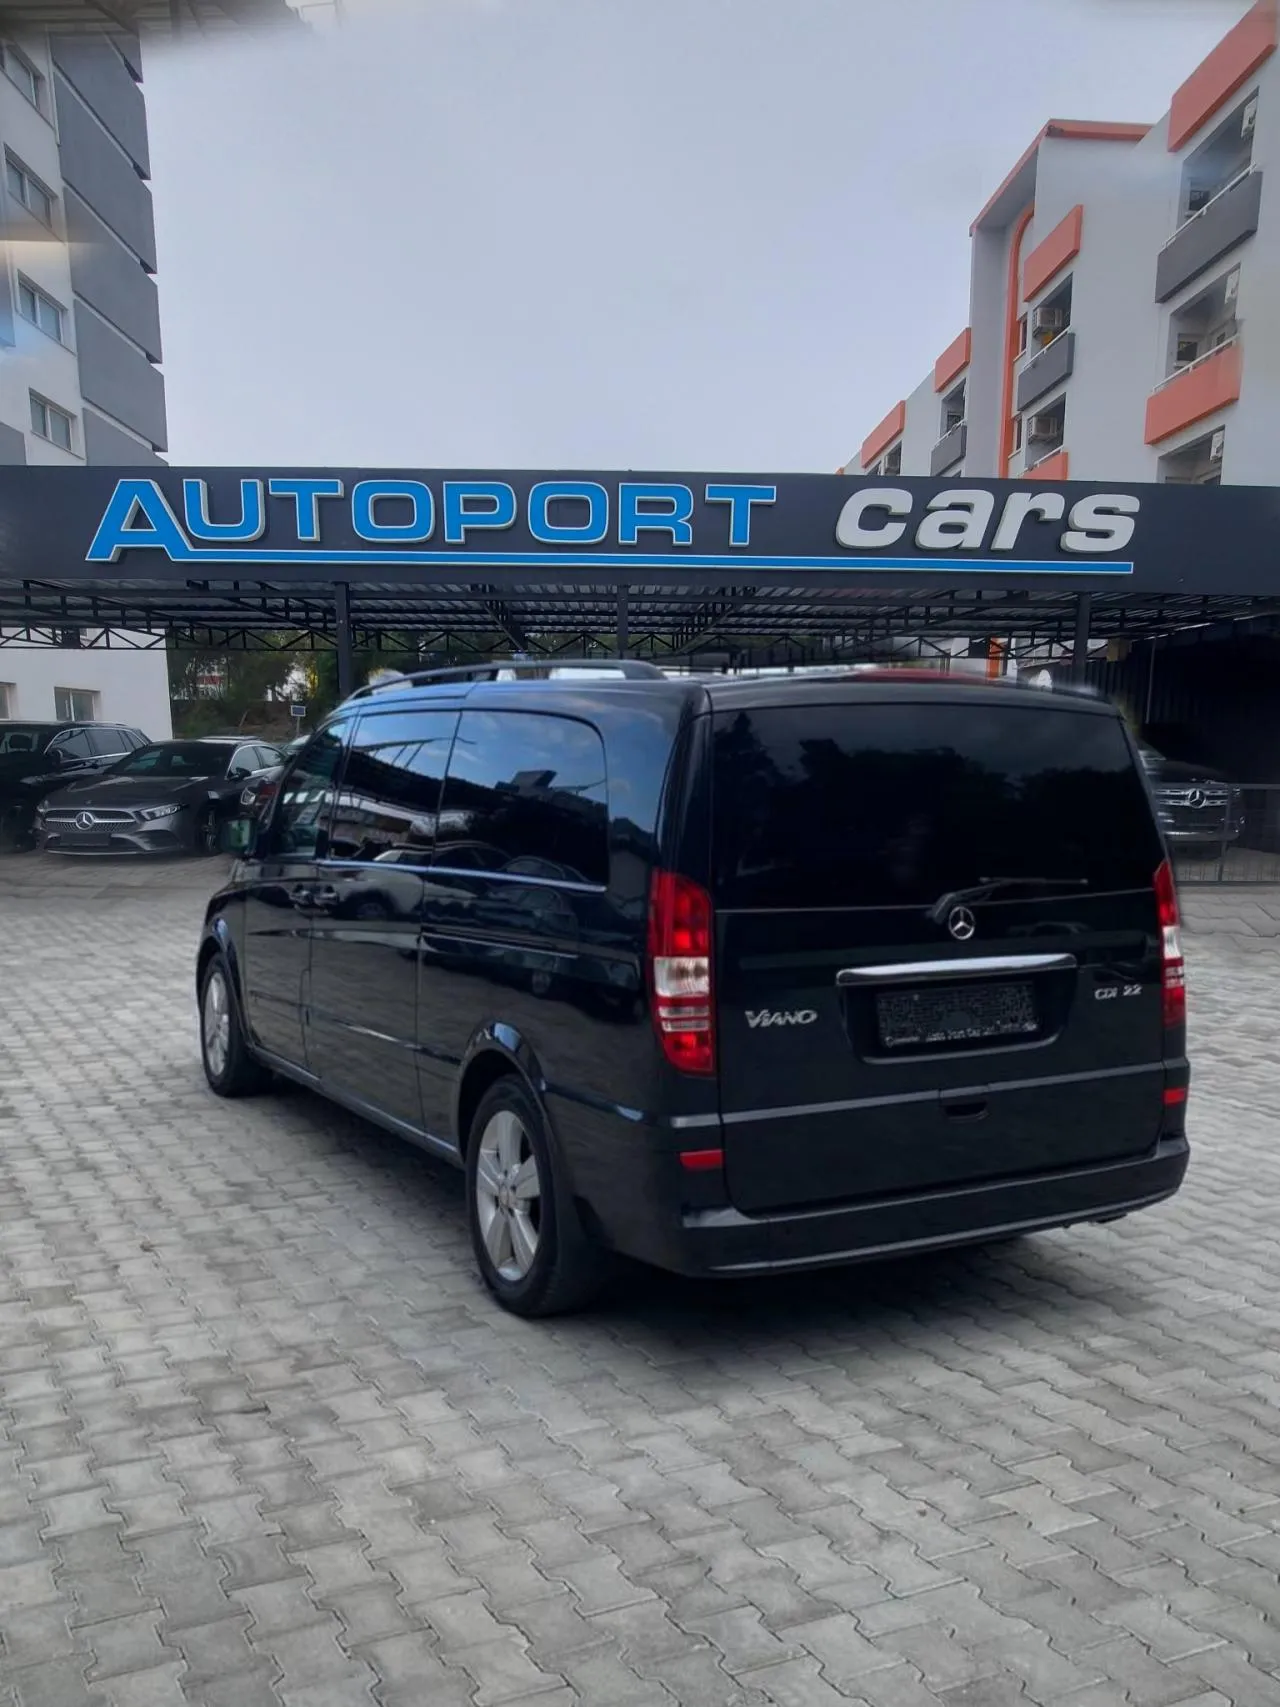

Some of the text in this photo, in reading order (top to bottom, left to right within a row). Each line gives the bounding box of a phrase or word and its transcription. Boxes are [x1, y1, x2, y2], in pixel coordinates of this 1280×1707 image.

[85, 478, 1141, 563] AUTOPORT cars
[744, 1009, 818, 1029] VIANO
